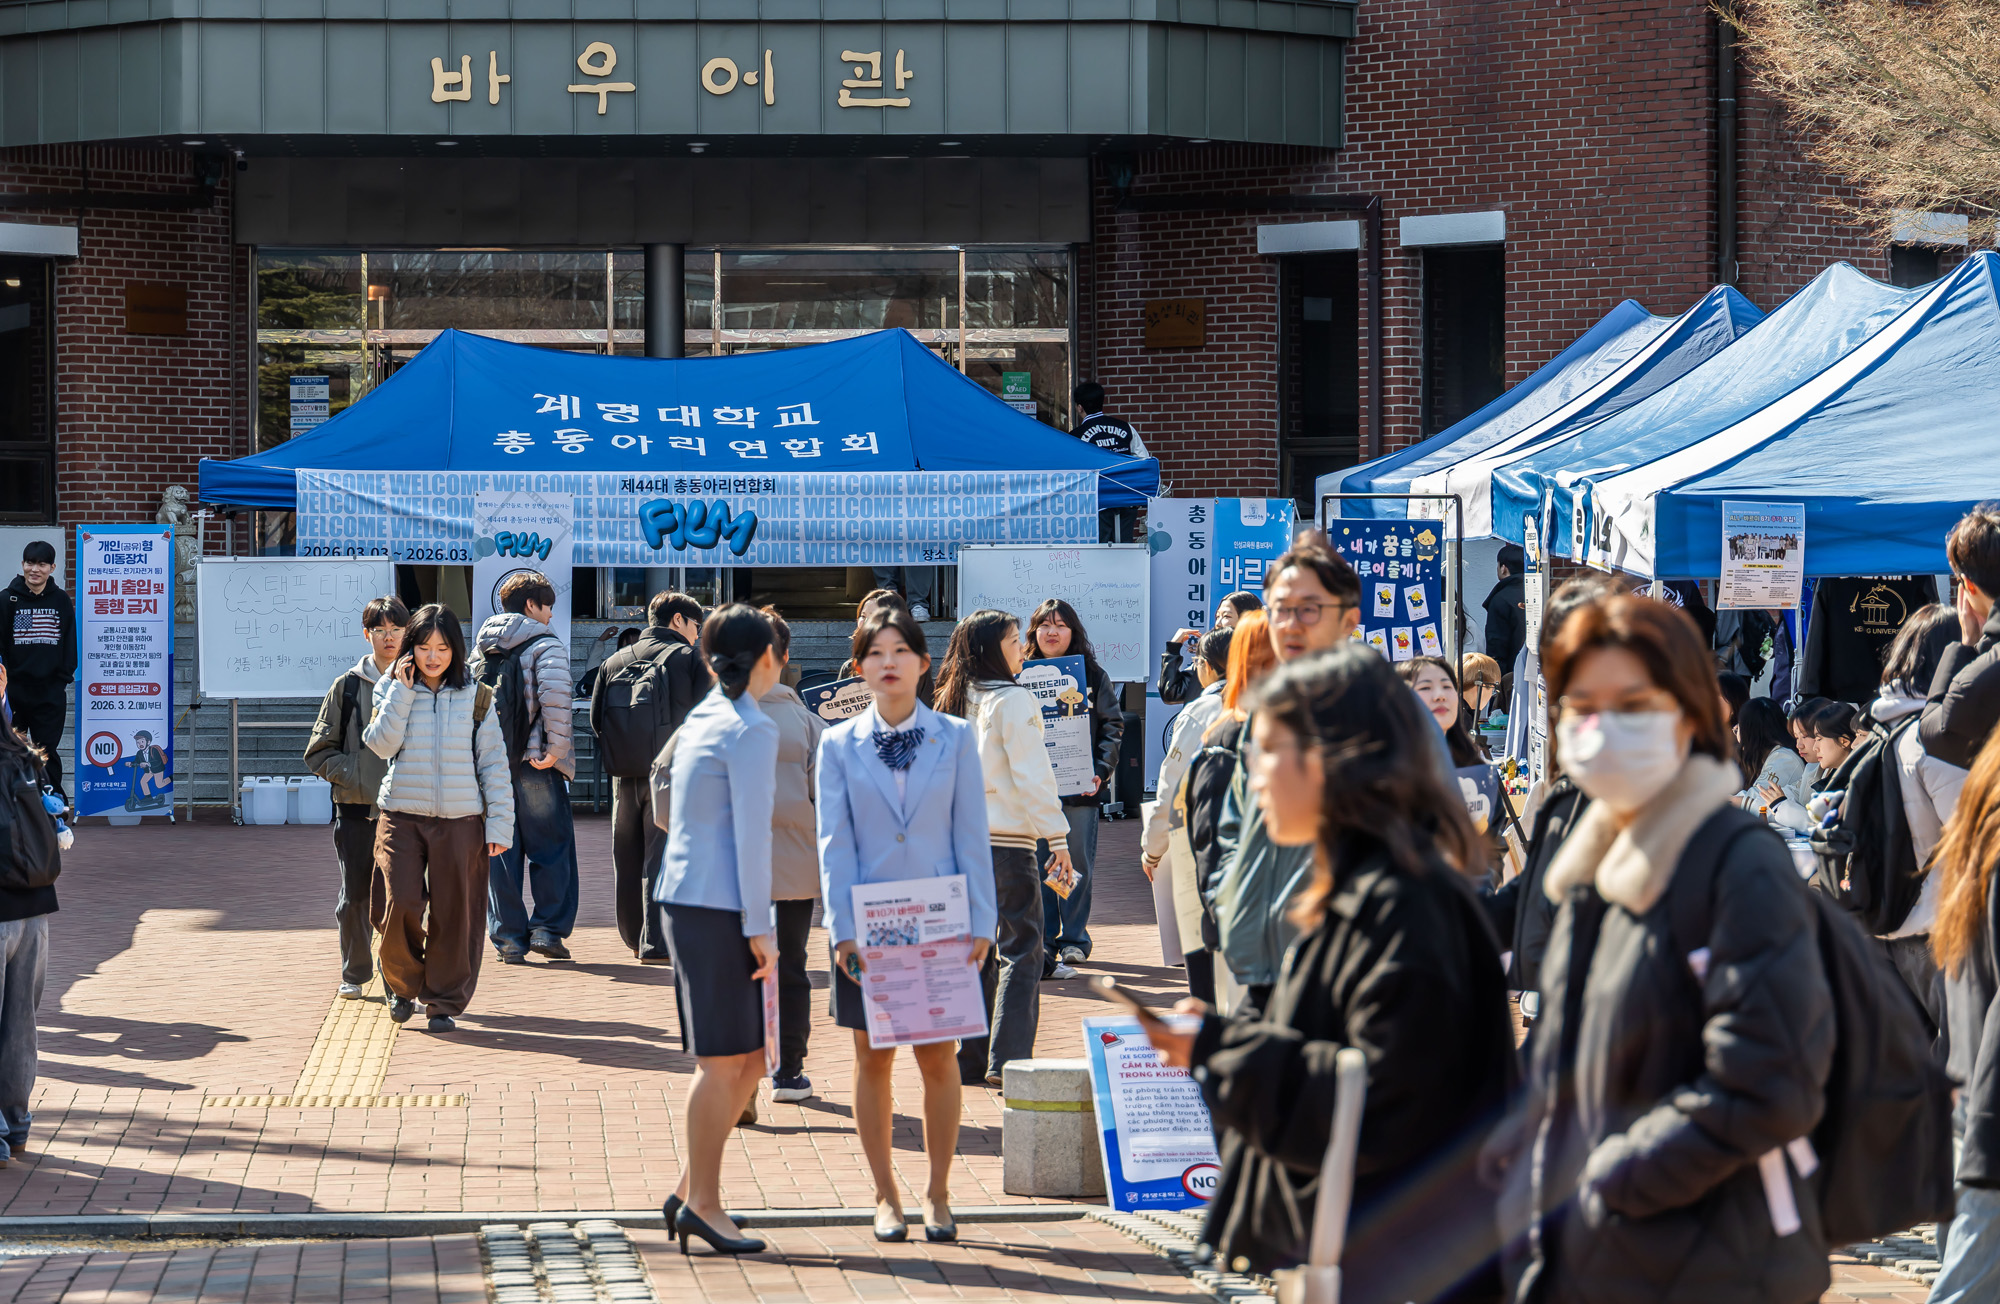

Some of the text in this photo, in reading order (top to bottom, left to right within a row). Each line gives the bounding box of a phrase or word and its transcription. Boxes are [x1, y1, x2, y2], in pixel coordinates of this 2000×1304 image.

[430, 41, 913, 115] 바우어관
[533, 393, 820, 429] 계명대학교
[1081, 425, 1127, 442] KEIMYUNG
[493, 428, 879, 459] 총동아리연합회
[1096, 438, 1118, 447] UNIV.
[493, 474, 593, 495] WELCOME
[804, 474, 903, 495] WELCOME
[906, 474, 1005, 495] WELCOME
[621, 478, 775, 494] 제44대 총동아리연합회
[391, 497, 474, 518] WELCOM
[804, 497, 903, 518] WELCOME
[906, 497, 1005, 518] WELCOME
[510, 516, 537, 524] 총동아리
[391, 518, 474, 539] WELCOM
[804, 520, 903, 541] WELCOME
[906, 519, 1005, 541] WELCOME
[638, 498, 758, 556] FILM
[98, 540, 153, 552] 개인(공유)형
[303, 546, 389, 556] 20260303
[494, 531, 552, 561] FILM
[1233, 541, 1273, 550] 인성교육원 홍보대사
[1351, 535, 1413, 557] 내가 꿈을
[104, 554, 147, 564] 이동장치
[391, 541, 474, 562] WELCOM
[804, 543, 903, 564] WELCOME
[922, 549, 946, 561] 장소
[1012, 556, 1086, 580] 본부 이벤트
[1188, 505, 1206, 653] 총동아리연
[88, 579, 164, 595] 교내 출입 및
[237, 574, 364, 606] 스탬프 티켓
[94, 599, 157, 614] 통행 금지
[1104, 613, 1118, 622] 이상
[1121, 613, 1141, 624] 넣으면
[103, 626, 147, 634] 교통사고 예방 및
[103, 669, 147, 677] 전면 금지합니다.
[100, 685, 149, 694] 전면 출입금지
[91, 701, 116, 710] 2026.
[118, 701, 126, 710] 3.
[841, 701, 872, 714] 10기모
[95, 743, 115, 755] NO!
[929, 903, 946, 912] 모집
[1156, 1070, 1192, 1078] KHUÔN
[1136, 1086, 1161, 1094] phòng
[1129, 1126, 1139, 1134] (xe
[1192, 1176, 1218, 1189] NO
